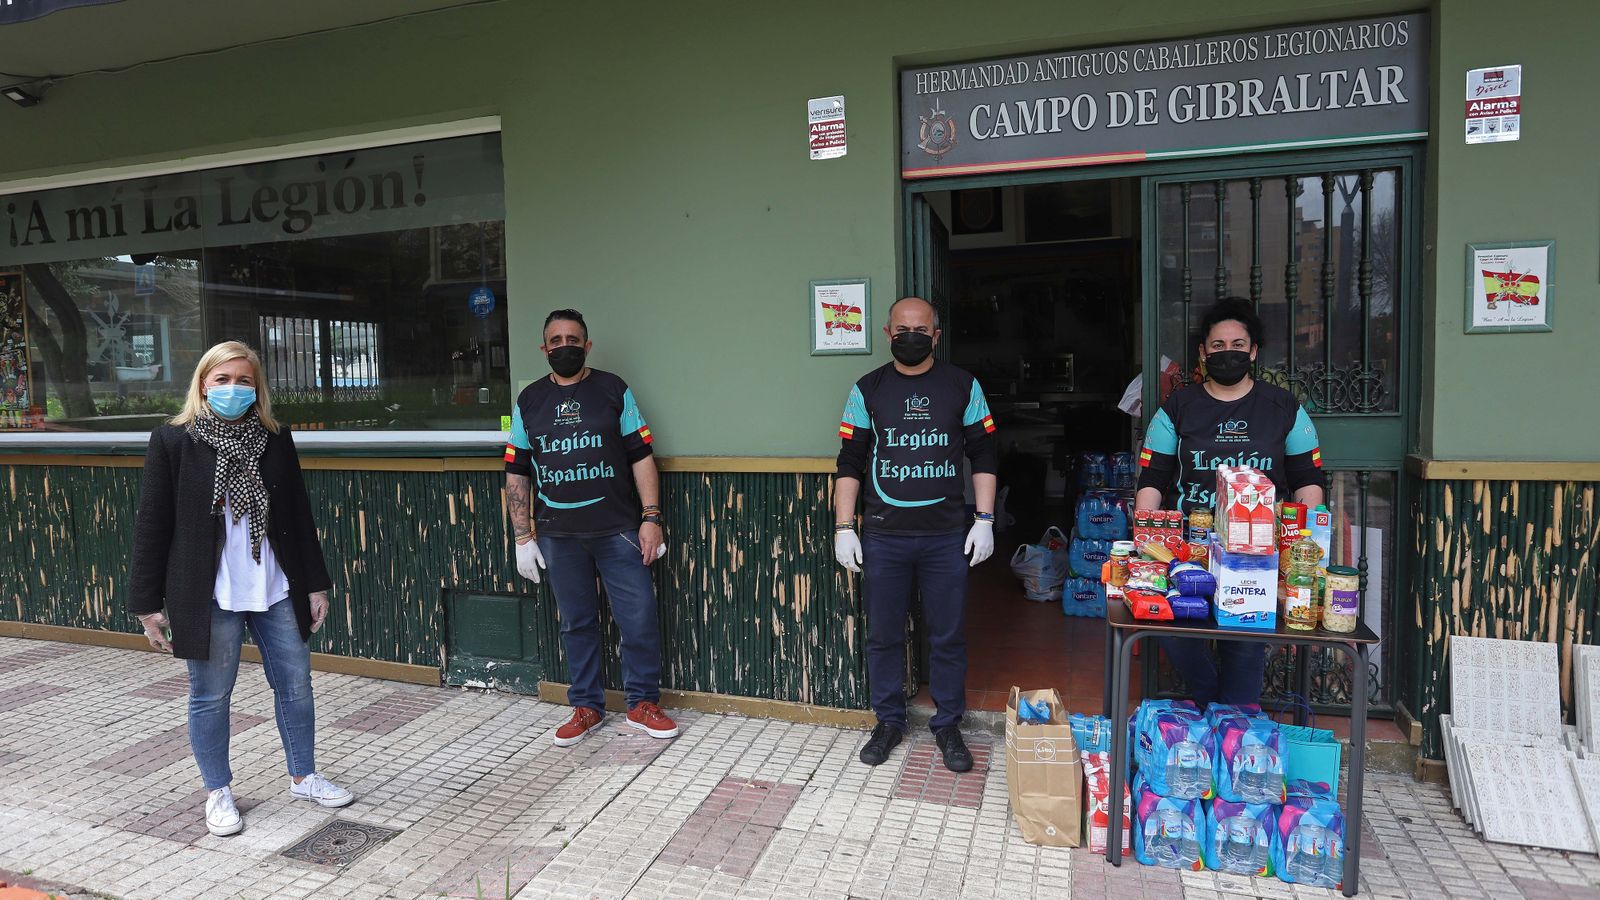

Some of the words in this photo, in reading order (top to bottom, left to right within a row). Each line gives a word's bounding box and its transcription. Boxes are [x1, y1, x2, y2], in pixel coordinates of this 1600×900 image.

[915, 61, 1030, 94] HERMANDAD
[1033, 50, 1129, 83] ANTIGUOS
[1132, 37, 1259, 72] CABALLEROS
[1263, 20, 1409, 59] LEGIONARIOS
[810, 106, 843, 116] verisure
[969, 93, 1098, 140] CAMPO
[1106, 88, 1159, 128] DE
[1167, 65, 1409, 124] GIBRALTAR
[1469, 100, 1518, 112] Alarma
[811, 122, 844, 132] Alarma
[8, 199, 56, 247] ¡A
[65, 186, 128, 242] mí
[140, 185, 201, 235] La
[215, 155, 426, 234] Legión!
[535, 430, 602, 455] Legión
[884, 427, 950, 451] Legión
[540, 461, 616, 486] Española
[880, 459, 956, 483] Española
[1281, 523, 1300, 537] Duo
